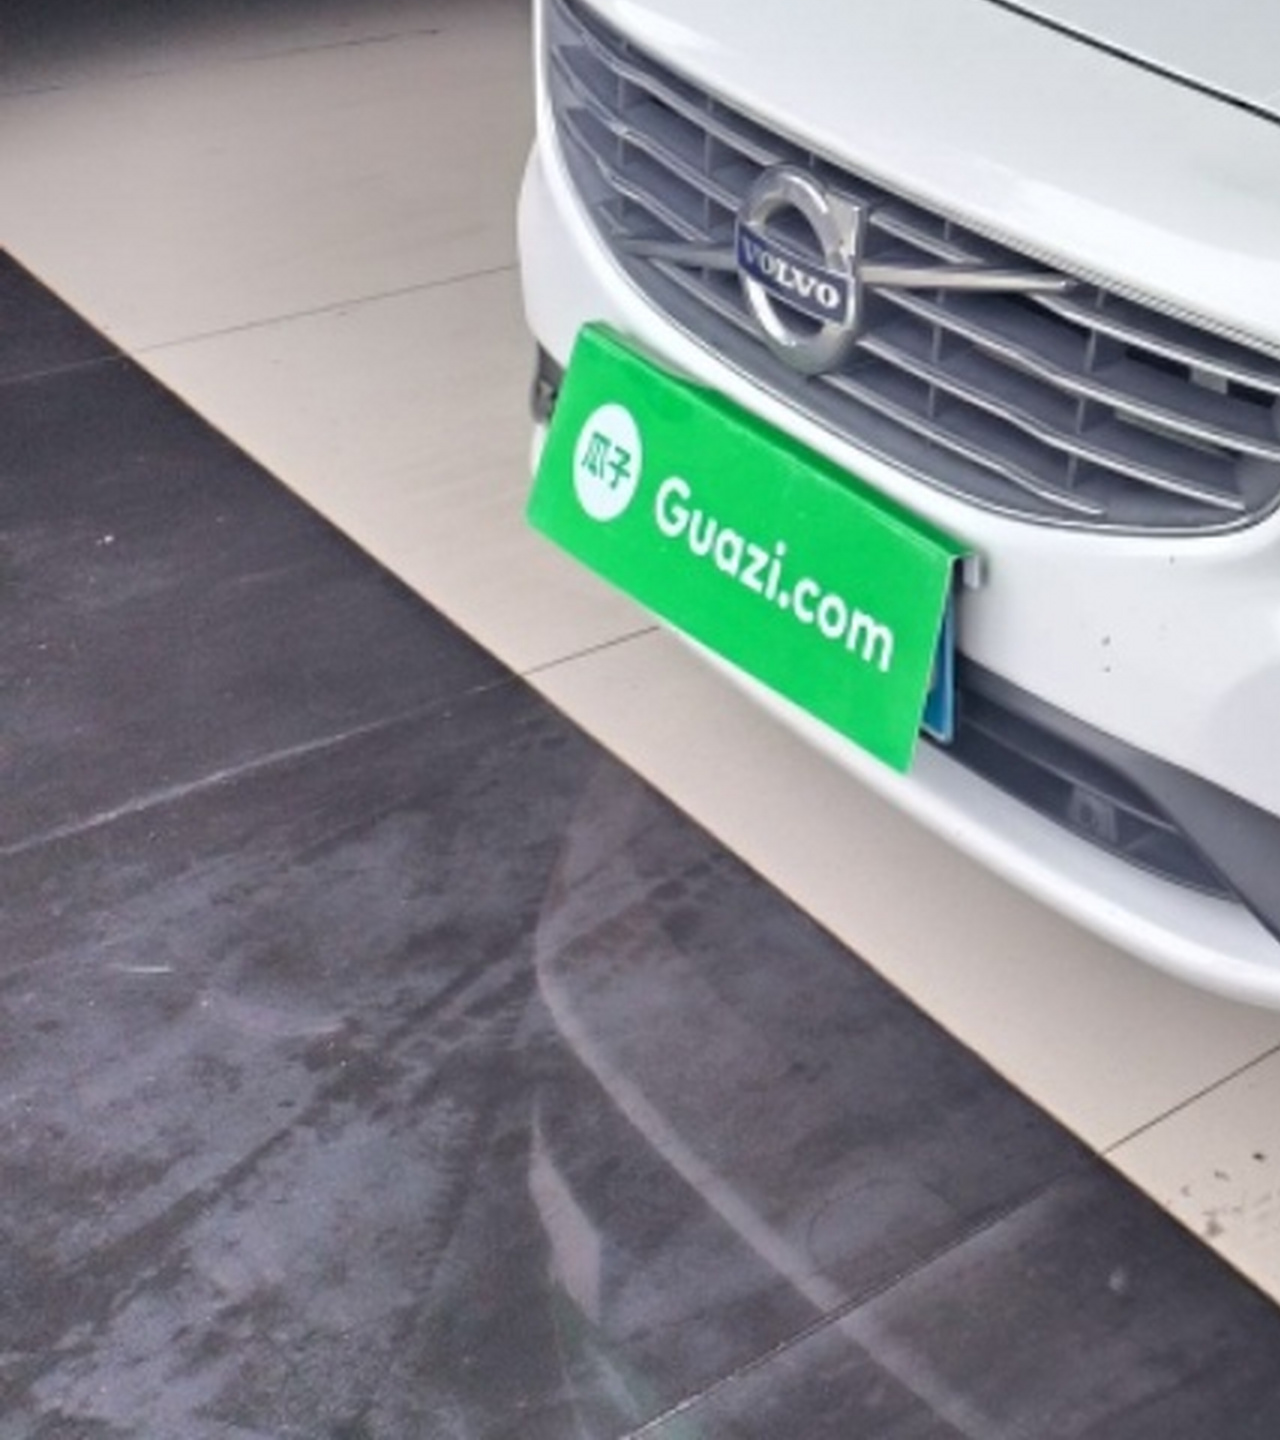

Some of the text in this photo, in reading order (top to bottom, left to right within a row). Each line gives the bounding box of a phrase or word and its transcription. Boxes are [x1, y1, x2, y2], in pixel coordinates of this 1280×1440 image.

[742, 236, 839, 309] VOLVO
[581, 430, 632, 490] 瓜子
[655, 476, 894, 673] Guazi.com
